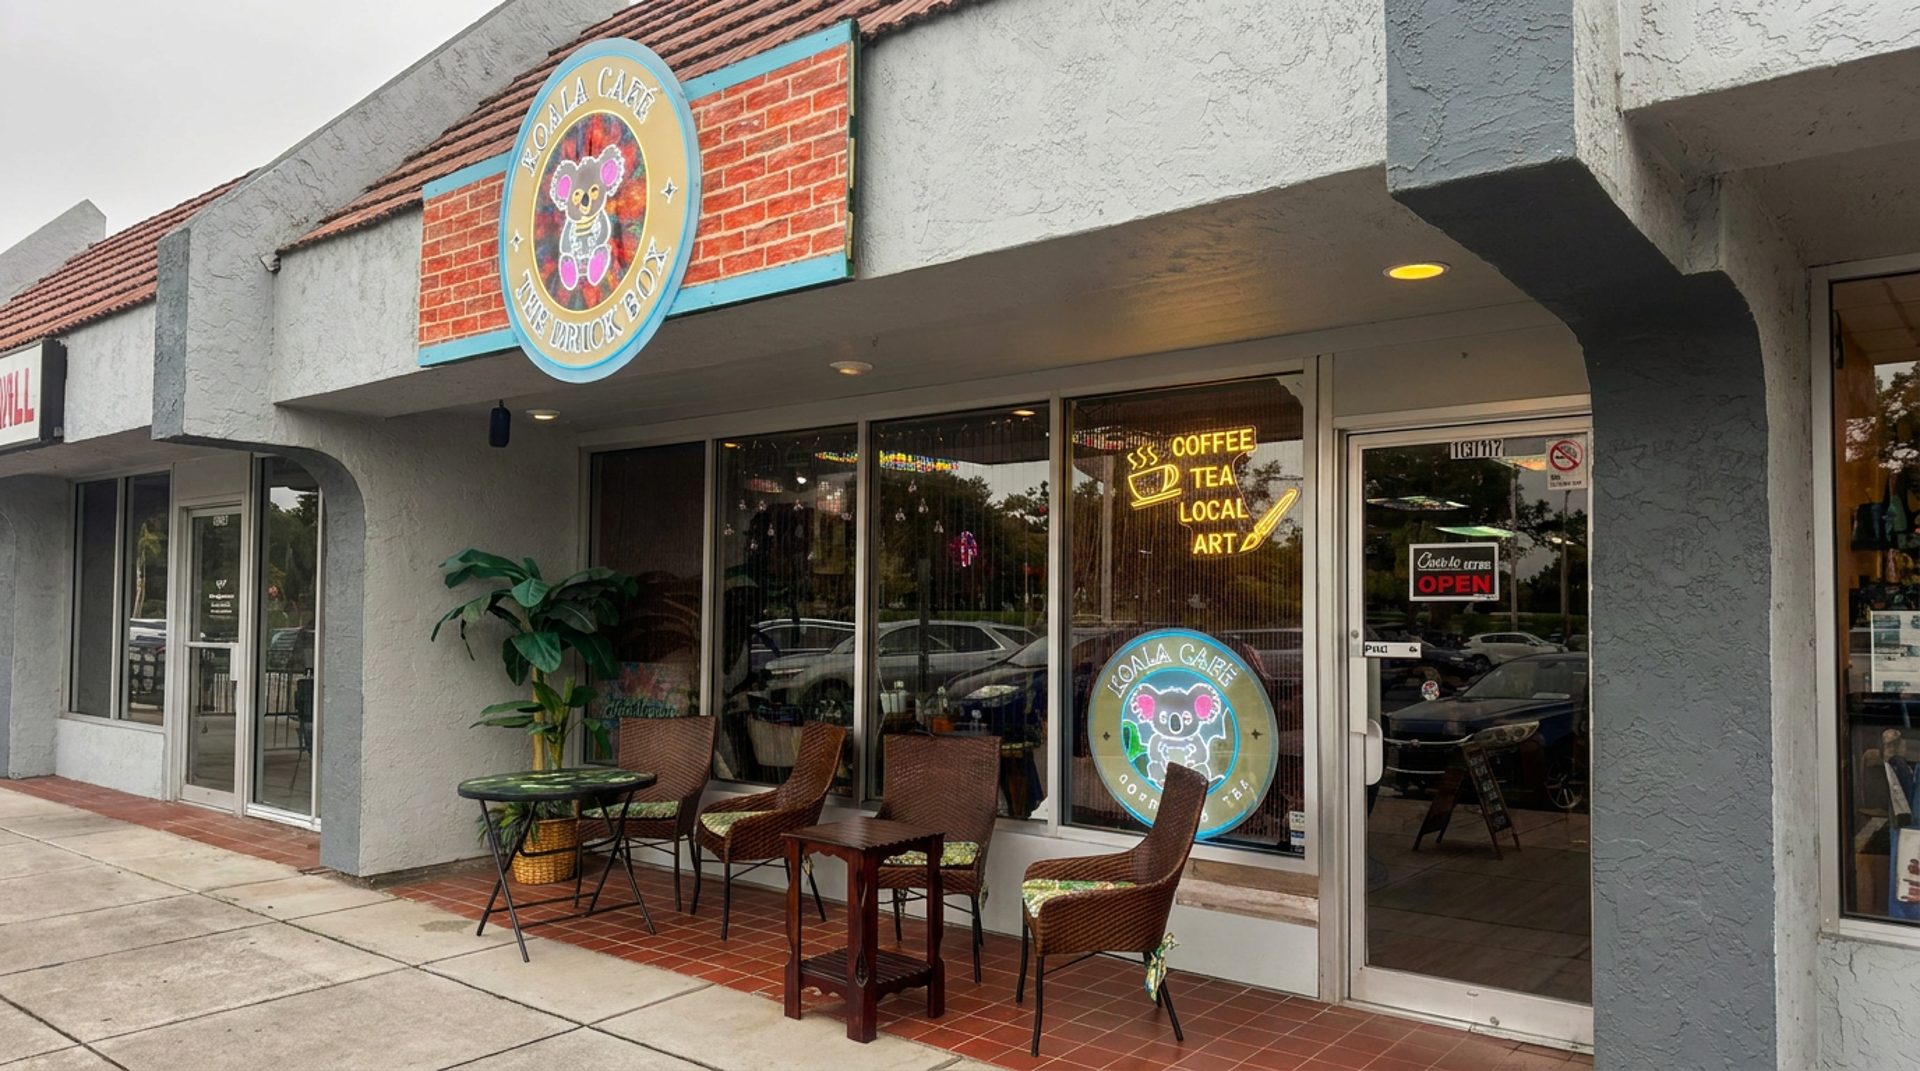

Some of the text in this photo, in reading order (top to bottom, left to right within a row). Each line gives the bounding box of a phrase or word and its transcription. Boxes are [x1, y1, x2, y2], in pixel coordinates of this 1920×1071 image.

[522, 76, 589, 177] KOALA
[1171, 427, 1255, 457] COFFEE
[1189, 465, 1235, 489] TEA
[1179, 498, 1250, 523] LOCAL
[1192, 532, 1238, 555] ART
[1418, 574, 1491, 593] OPEN
[1107, 643, 1173, 698] KOALA
